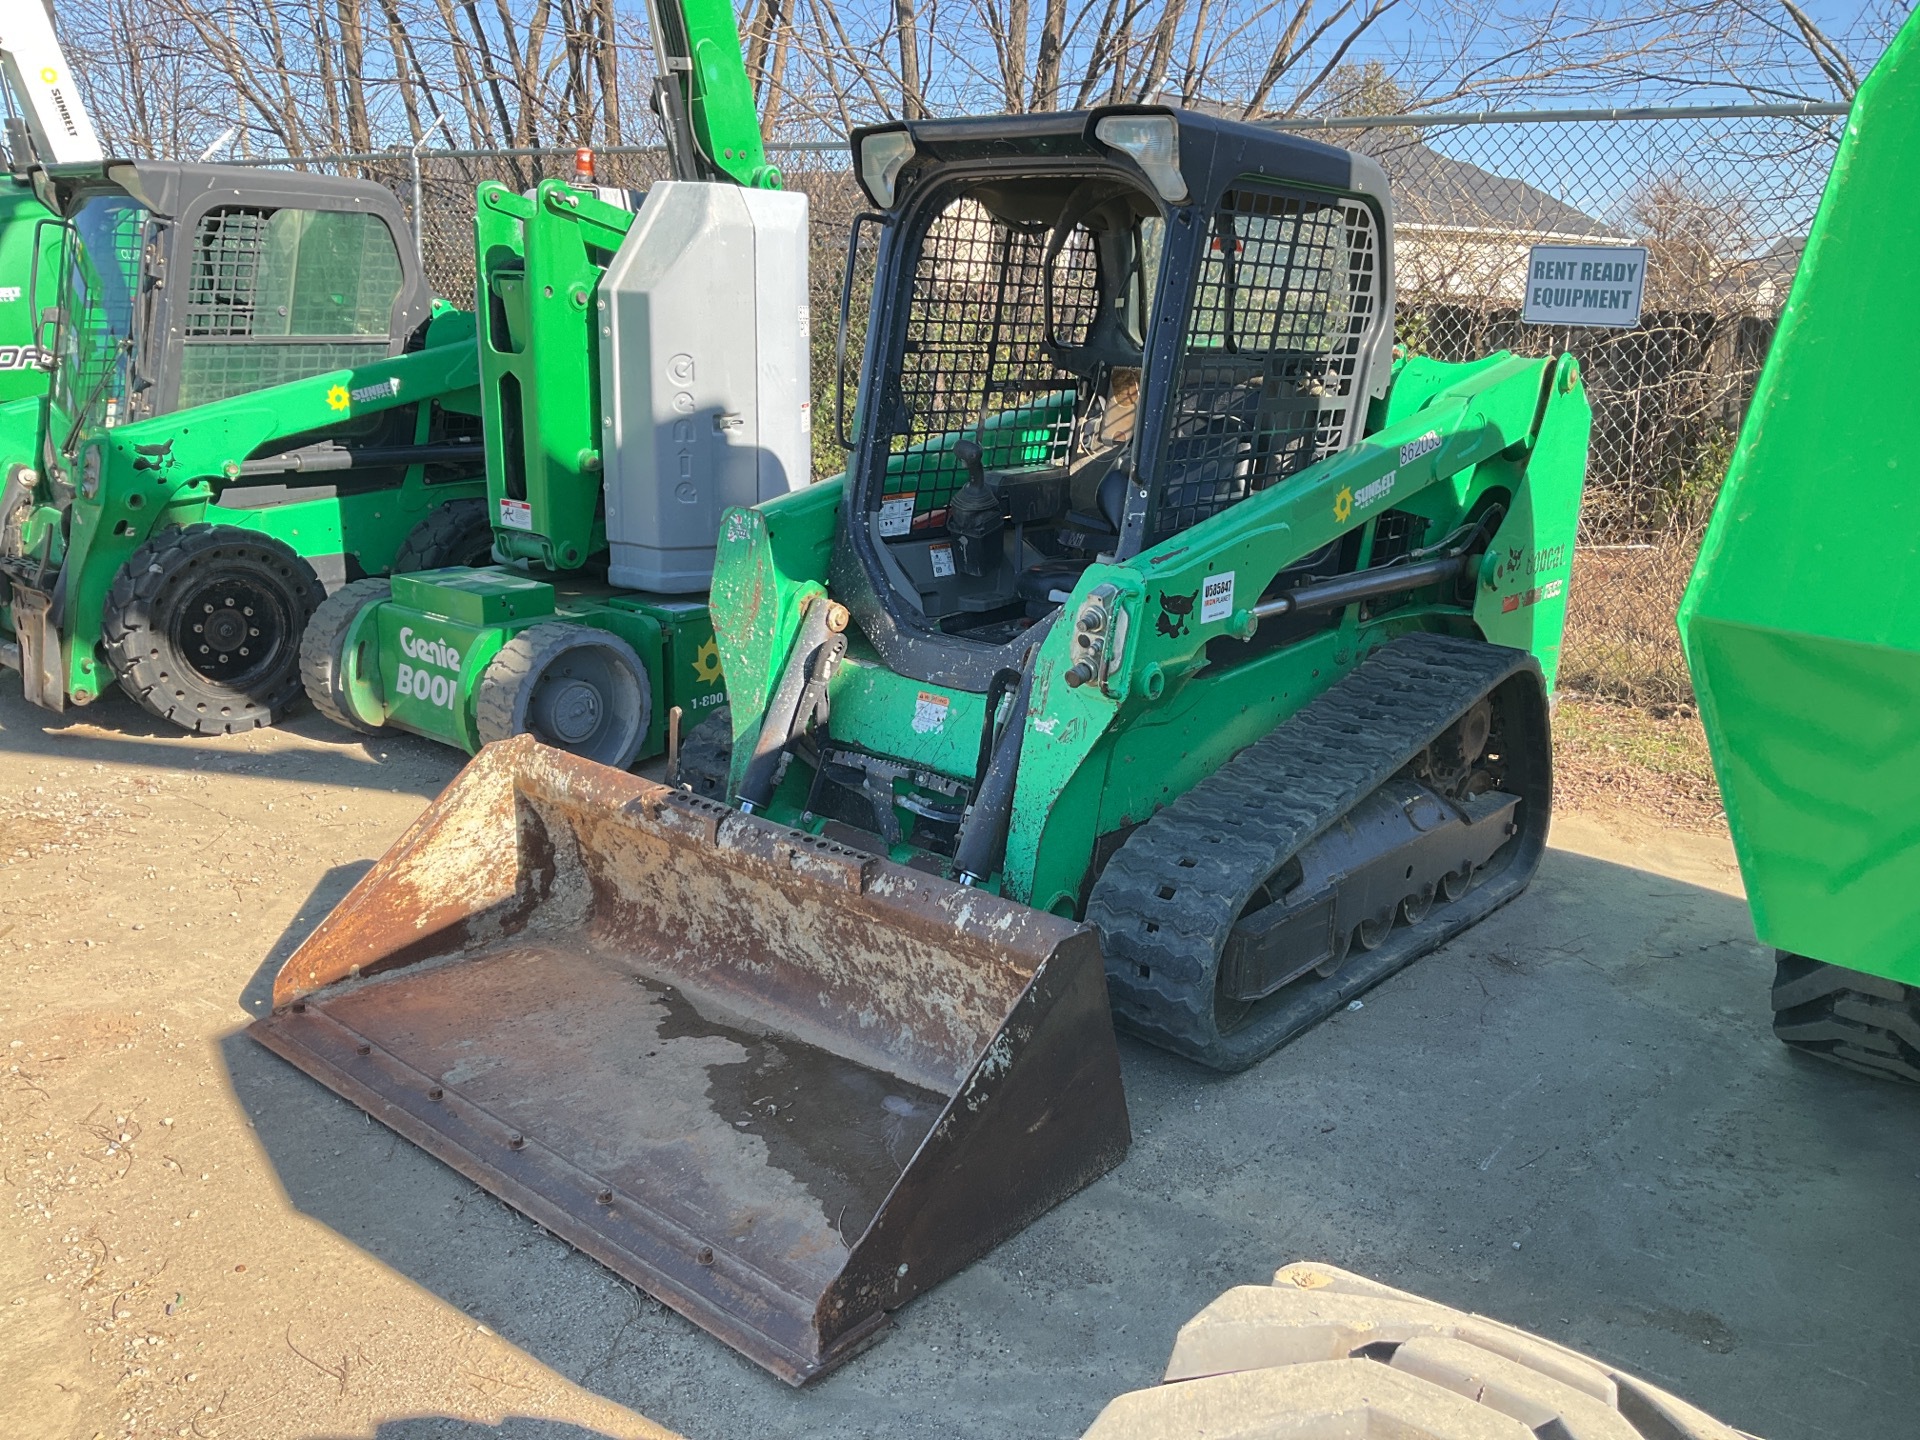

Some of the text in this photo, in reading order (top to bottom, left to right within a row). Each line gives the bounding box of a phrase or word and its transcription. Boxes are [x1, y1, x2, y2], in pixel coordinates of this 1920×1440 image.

[51, 88, 78, 137] SUNBELT
[1533, 261, 1639, 283] RENT READY
[1532, 287, 1633, 310] EQUIPMENT
[1354, 469, 1396, 507] SUNBELT
[399, 626, 461, 673] Genie
